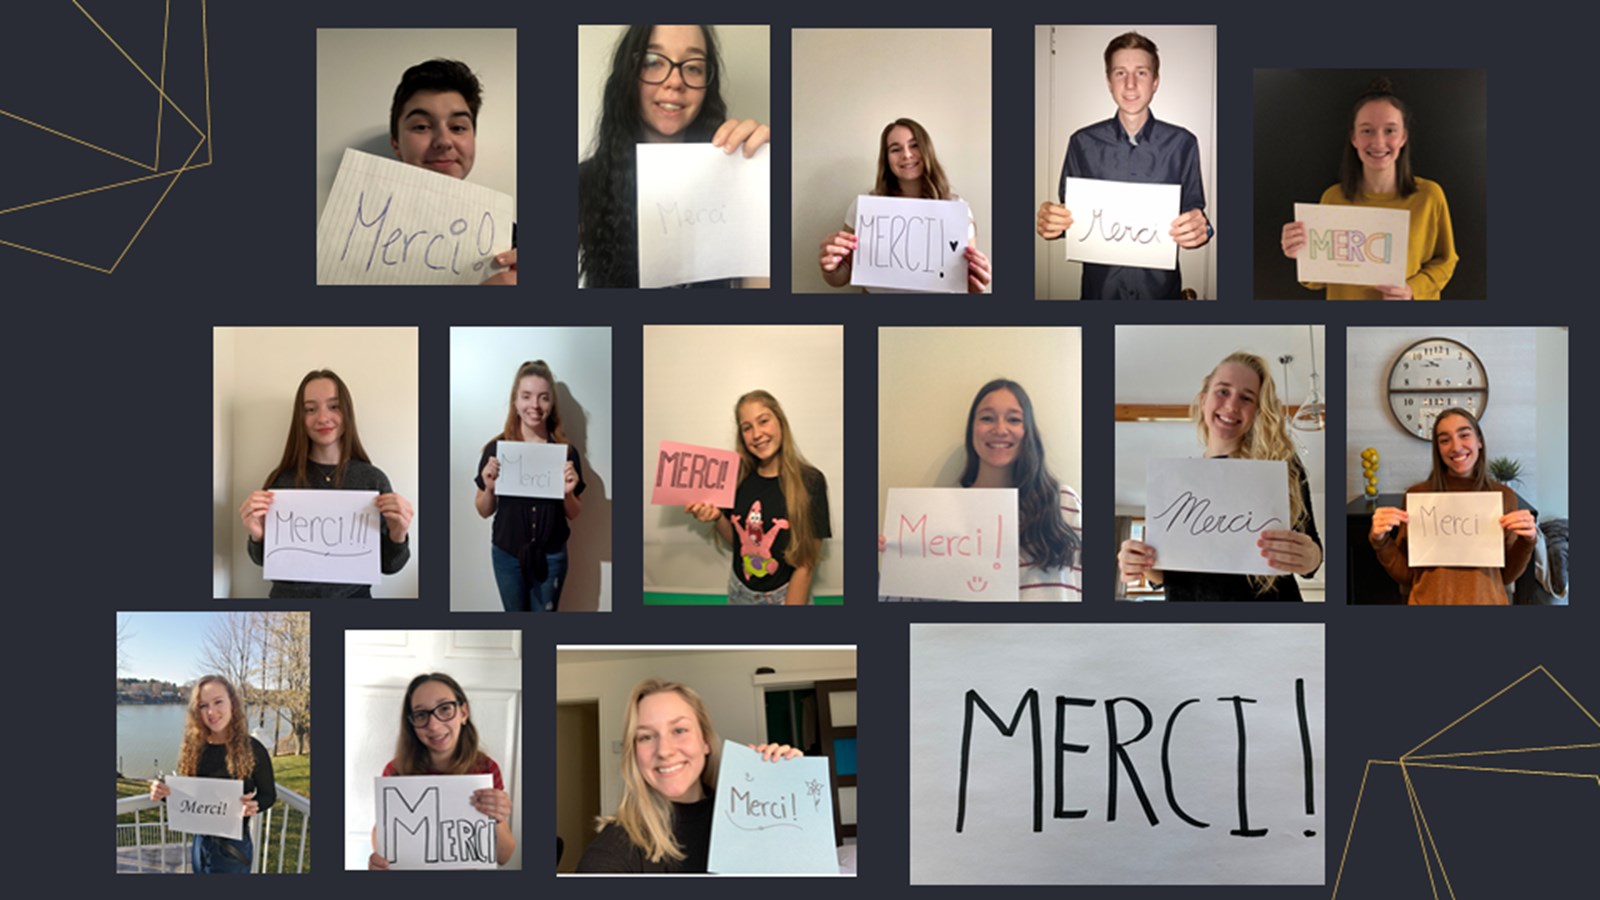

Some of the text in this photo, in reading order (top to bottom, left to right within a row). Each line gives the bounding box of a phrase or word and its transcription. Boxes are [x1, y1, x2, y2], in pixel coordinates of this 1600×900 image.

[340, 191, 495, 276] Merci!
[656, 201, 727, 235] Merci
[1078, 208, 1162, 245] Merci
[857, 214, 945, 279] MERCI!
[1308, 228, 1393, 265] MERCI
[501, 453, 551, 488] Merci
[656, 450, 729, 490] MERCI!
[1153, 491, 1283, 536] Merci
[1419, 505, 1479, 537] Merci
[180, 799, 228, 816] Merci!
[731, 786, 798, 821] Merci!
[383, 786, 497, 864] MERCI
